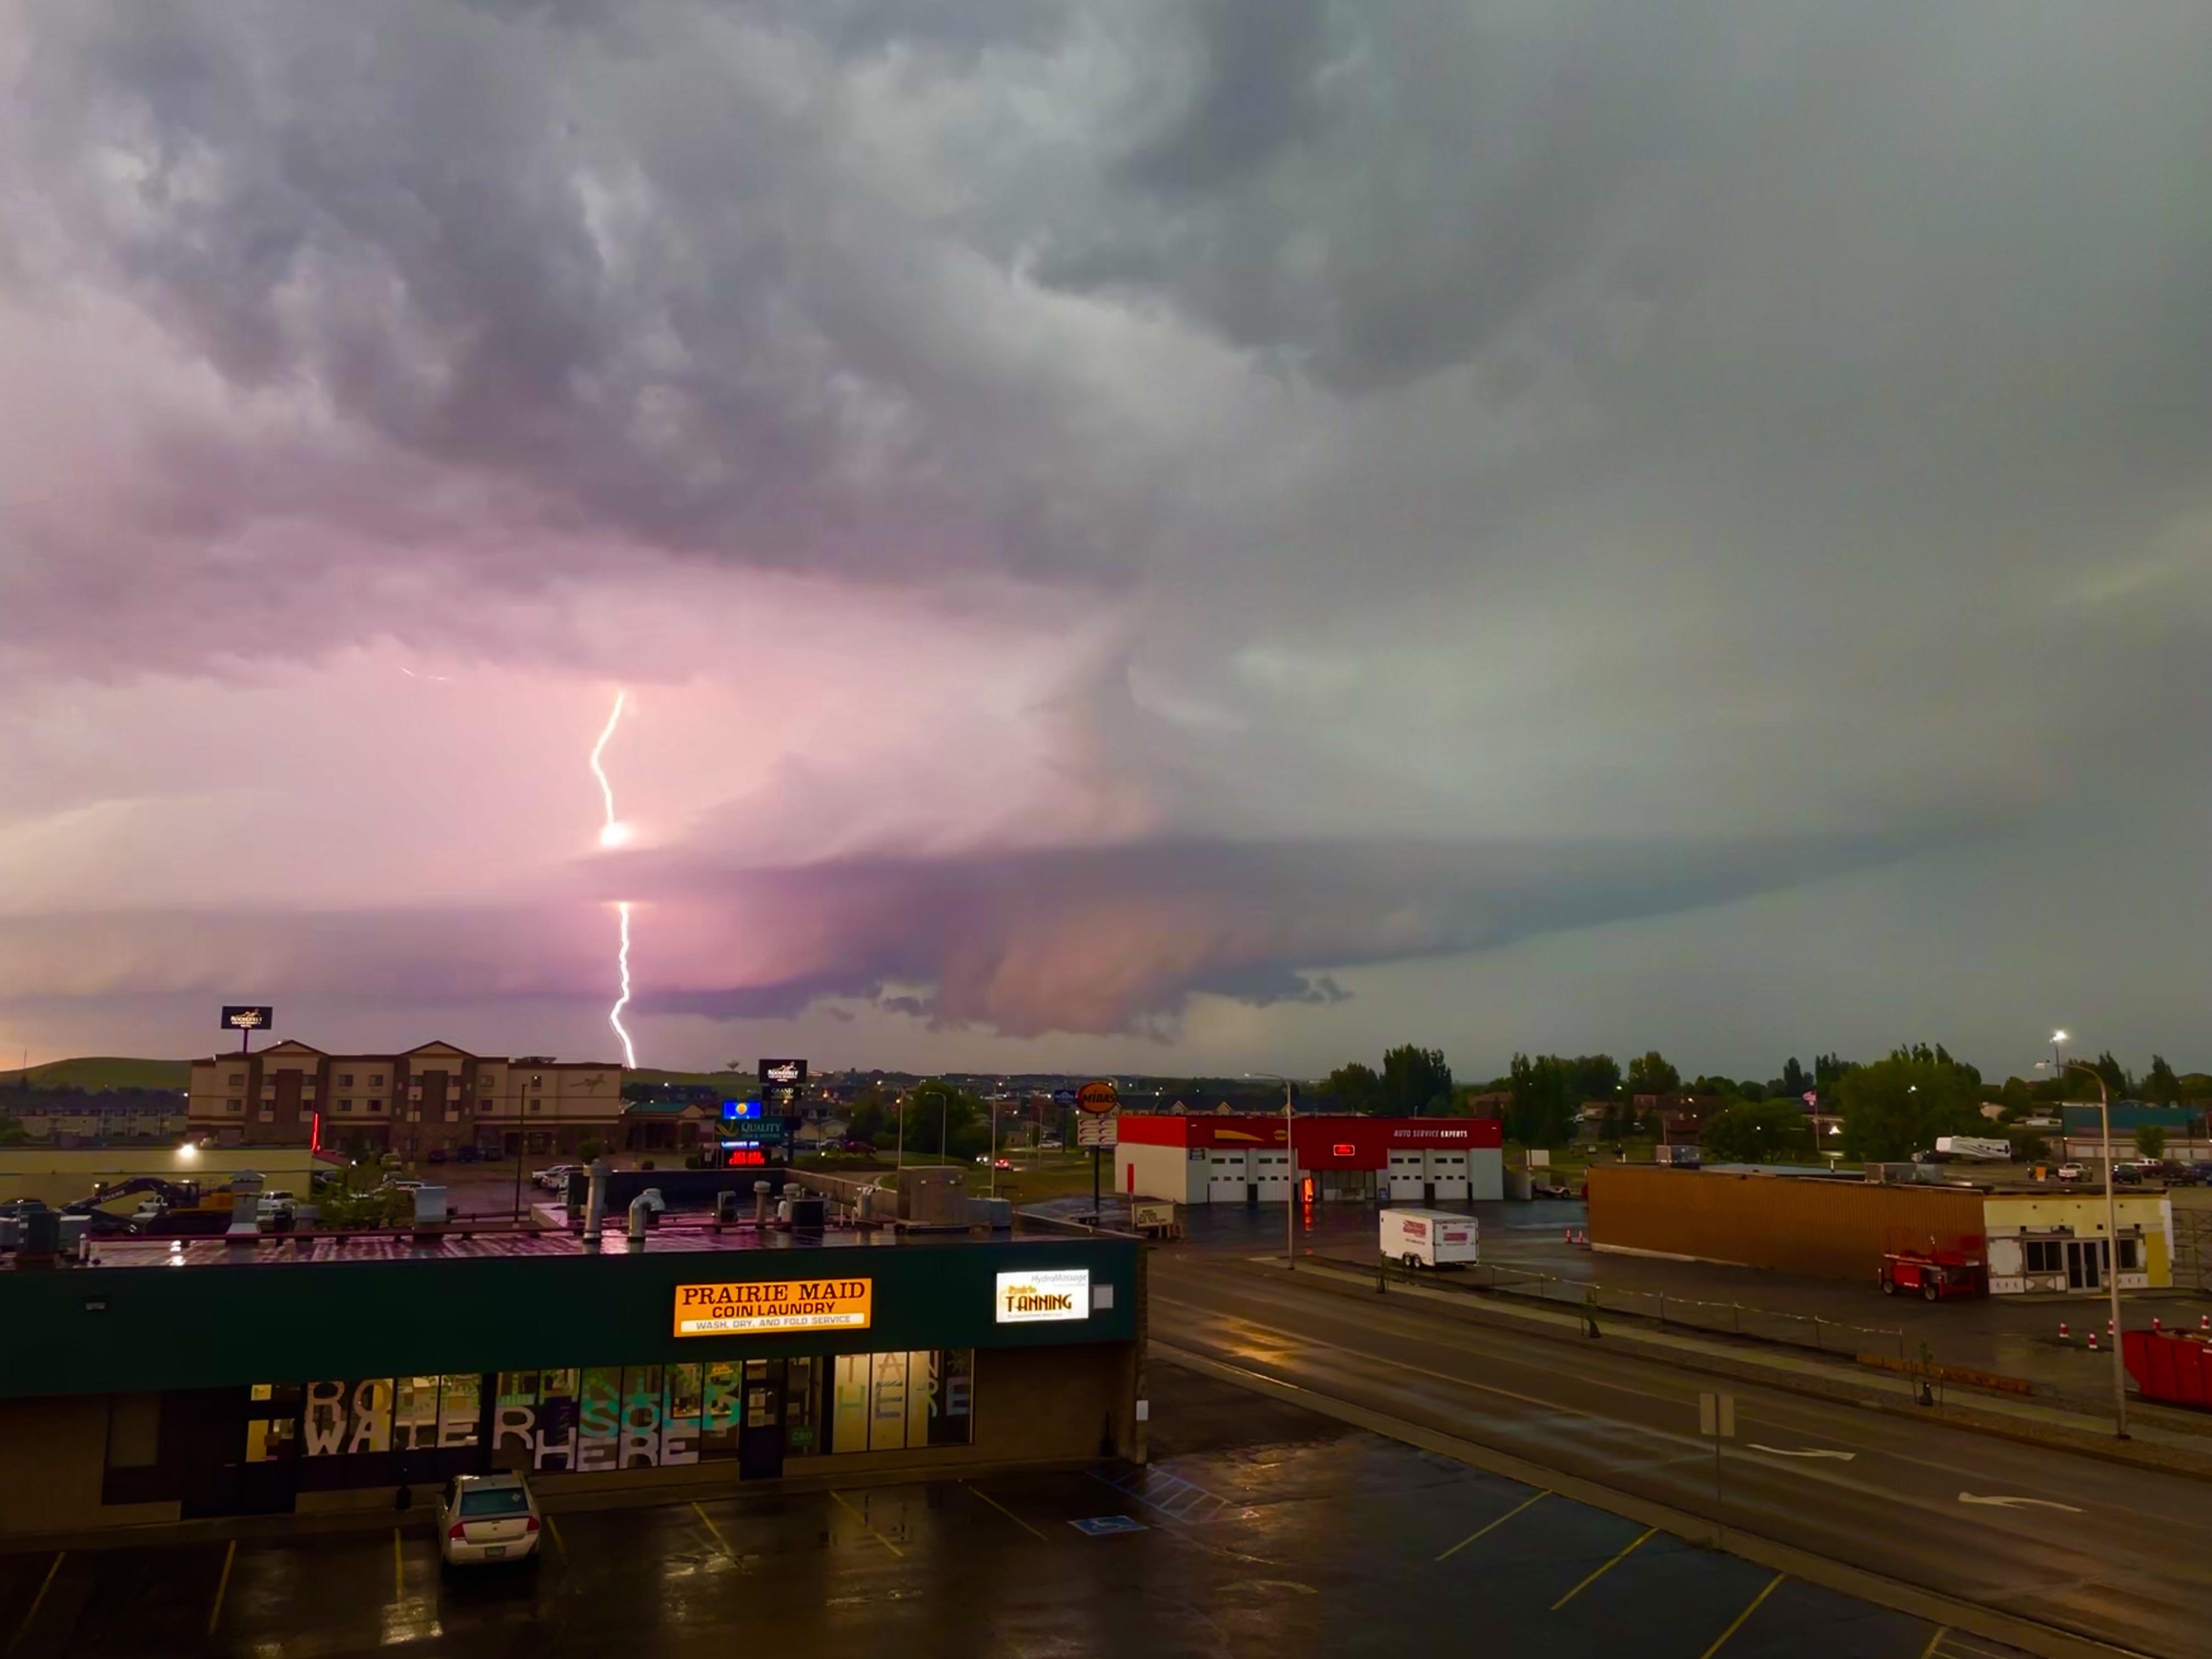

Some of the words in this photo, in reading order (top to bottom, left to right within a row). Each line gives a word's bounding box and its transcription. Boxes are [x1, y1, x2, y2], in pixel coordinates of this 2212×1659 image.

[1083, 1091, 1115, 1103] MIDAS
[741, 1122, 781, 1133] QUALITY
[1393, 1130, 1410, 1138] AUTO
[1413, 1130, 1440, 1138] SERVICE
[1440, 1130, 1468, 1138] EXPERTS
[1031, 1273, 1087, 1284] HydroMassage
[682, 1285, 788, 1305] PRAIRIE
[798, 1282, 865, 1301] MAID
[713, 1305, 753, 1318] COIN
[757, 1301, 836, 1316] LAUNDRY
[1005, 1294, 1073, 1312] TANNING
[696, 1322, 730, 1330] WASH,
[732, 1320, 755, 1328] DRY,
[811, 1316, 851, 1324] SERVICE
[303, 1406, 535, 1456] WATER
[533, 1426, 699, 1472] HERE
